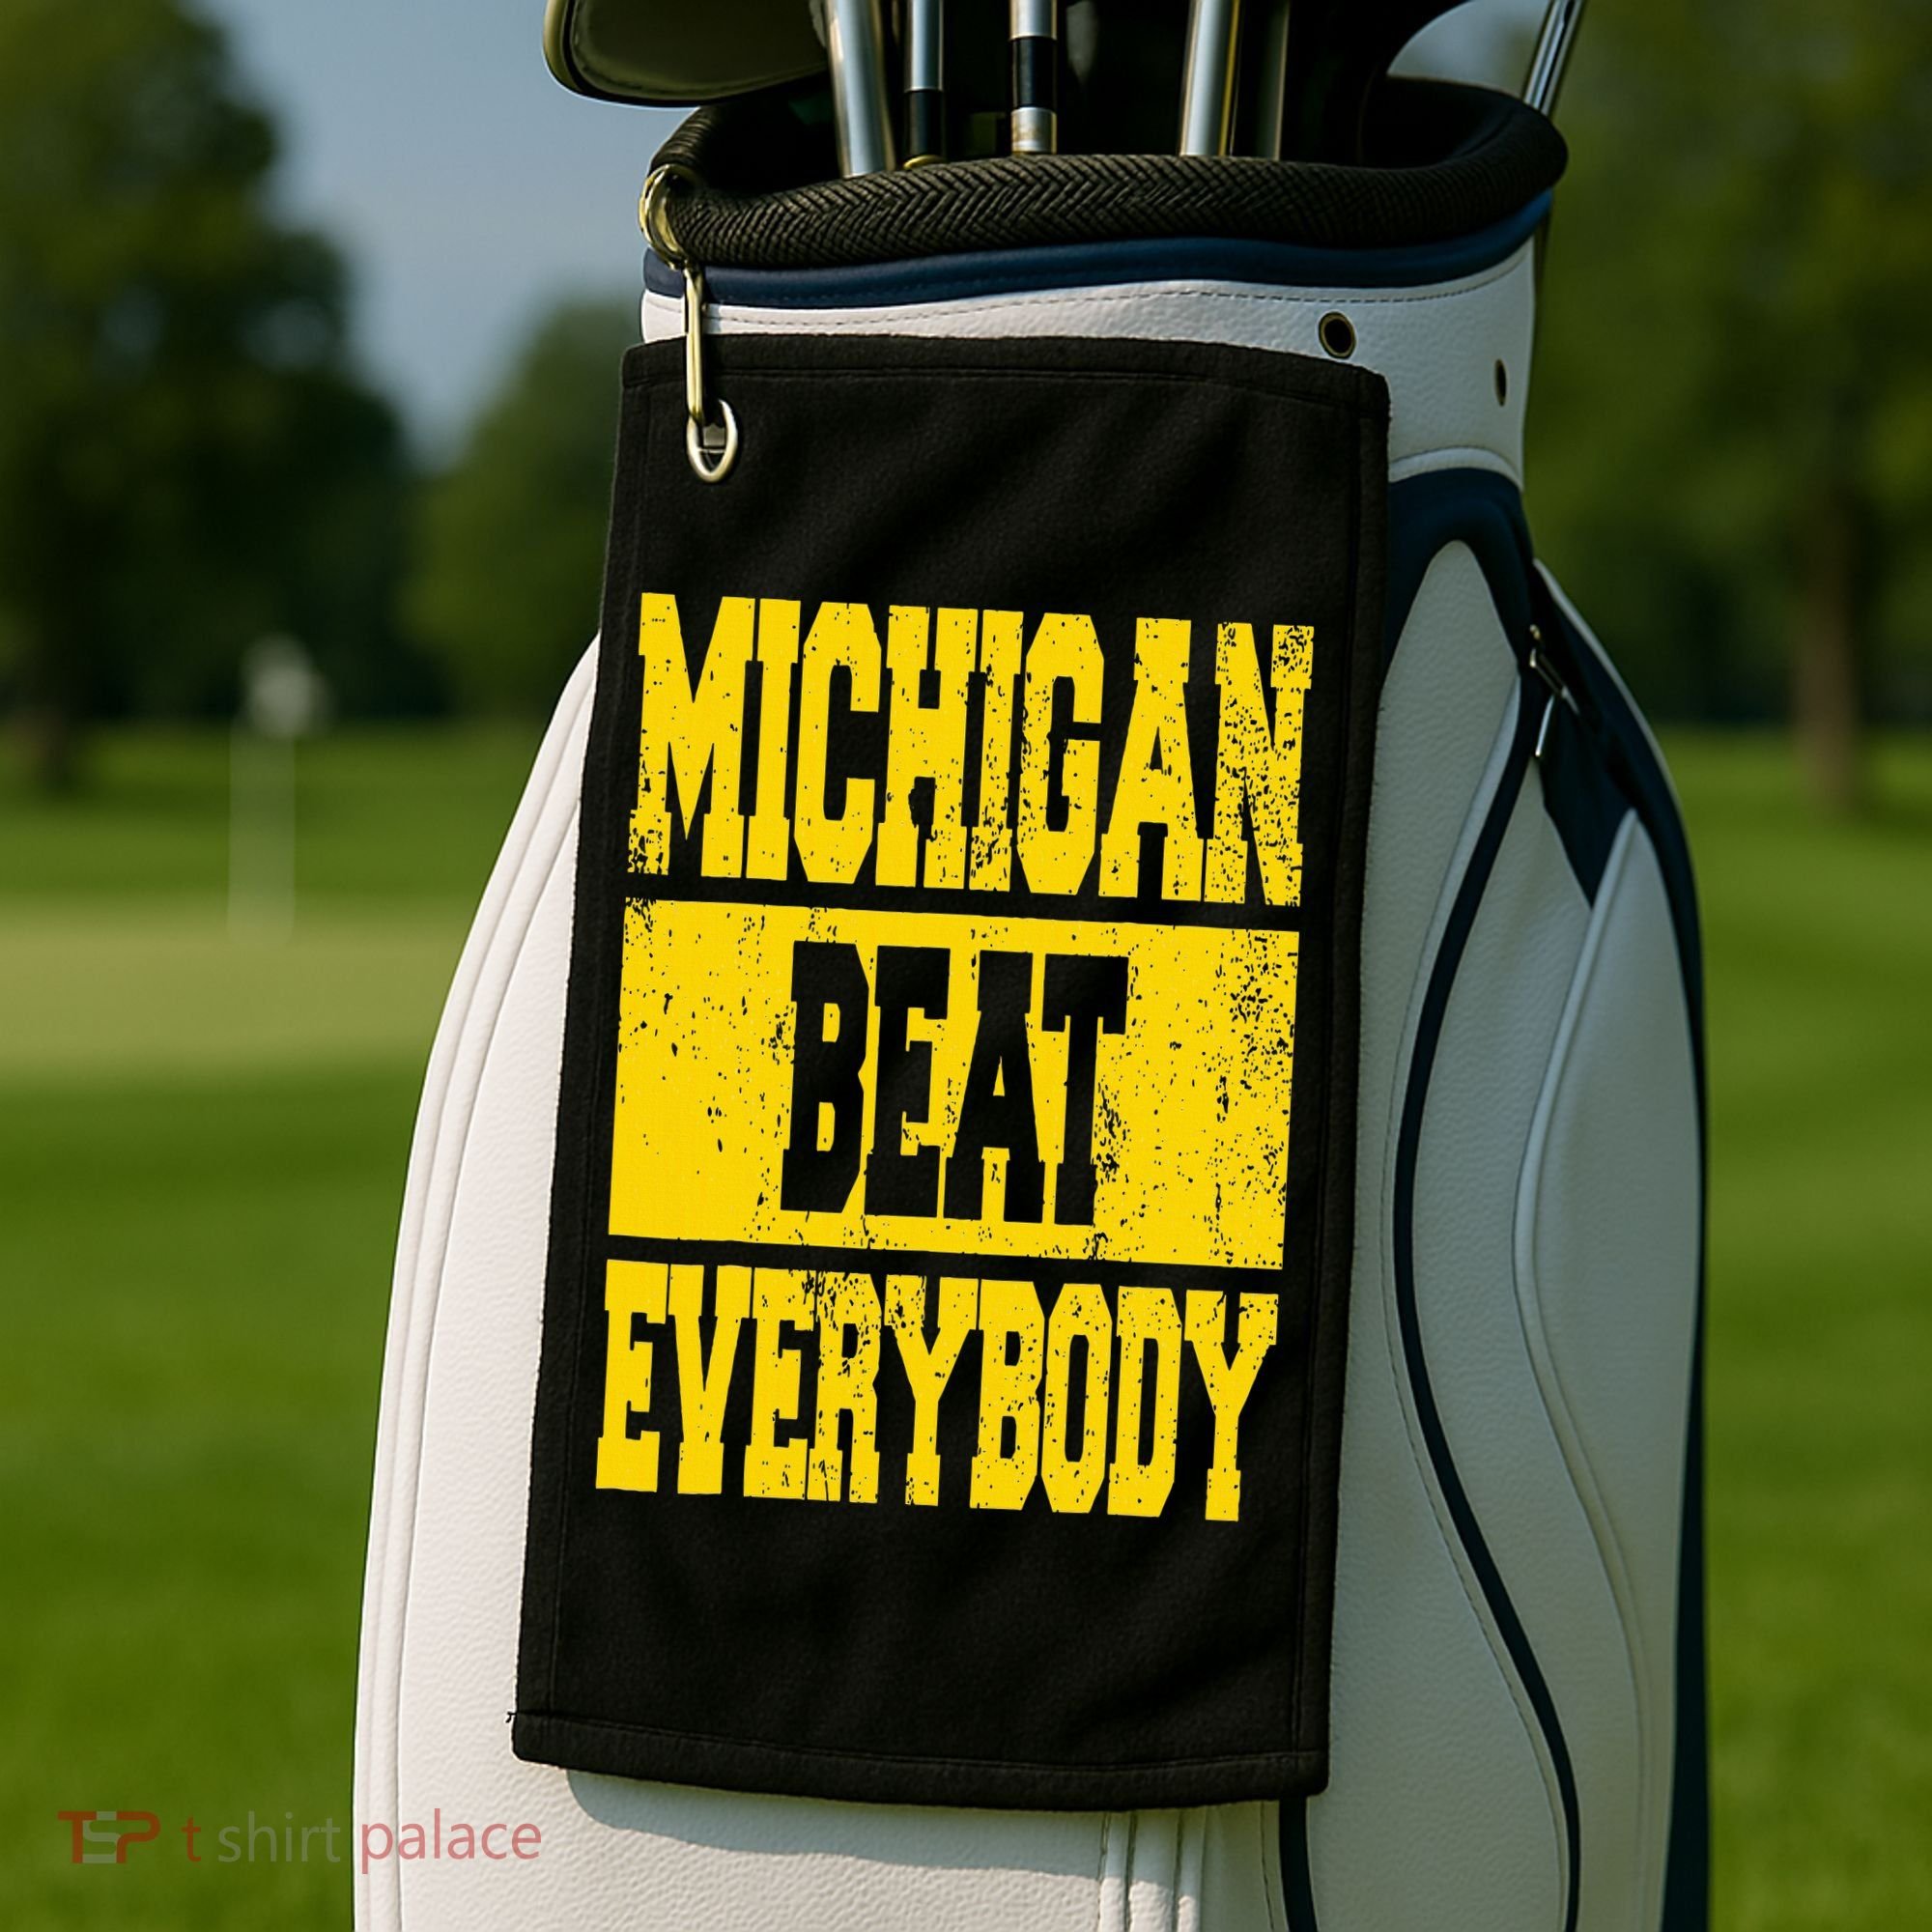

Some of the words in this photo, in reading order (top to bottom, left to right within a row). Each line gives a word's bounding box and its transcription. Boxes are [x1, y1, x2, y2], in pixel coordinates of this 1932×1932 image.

[628, 592, 1315, 906] MICHIGAN
[781, 940, 1129, 1226] BEAT
[595, 1259, 1279, 1522] EVERYBODY
